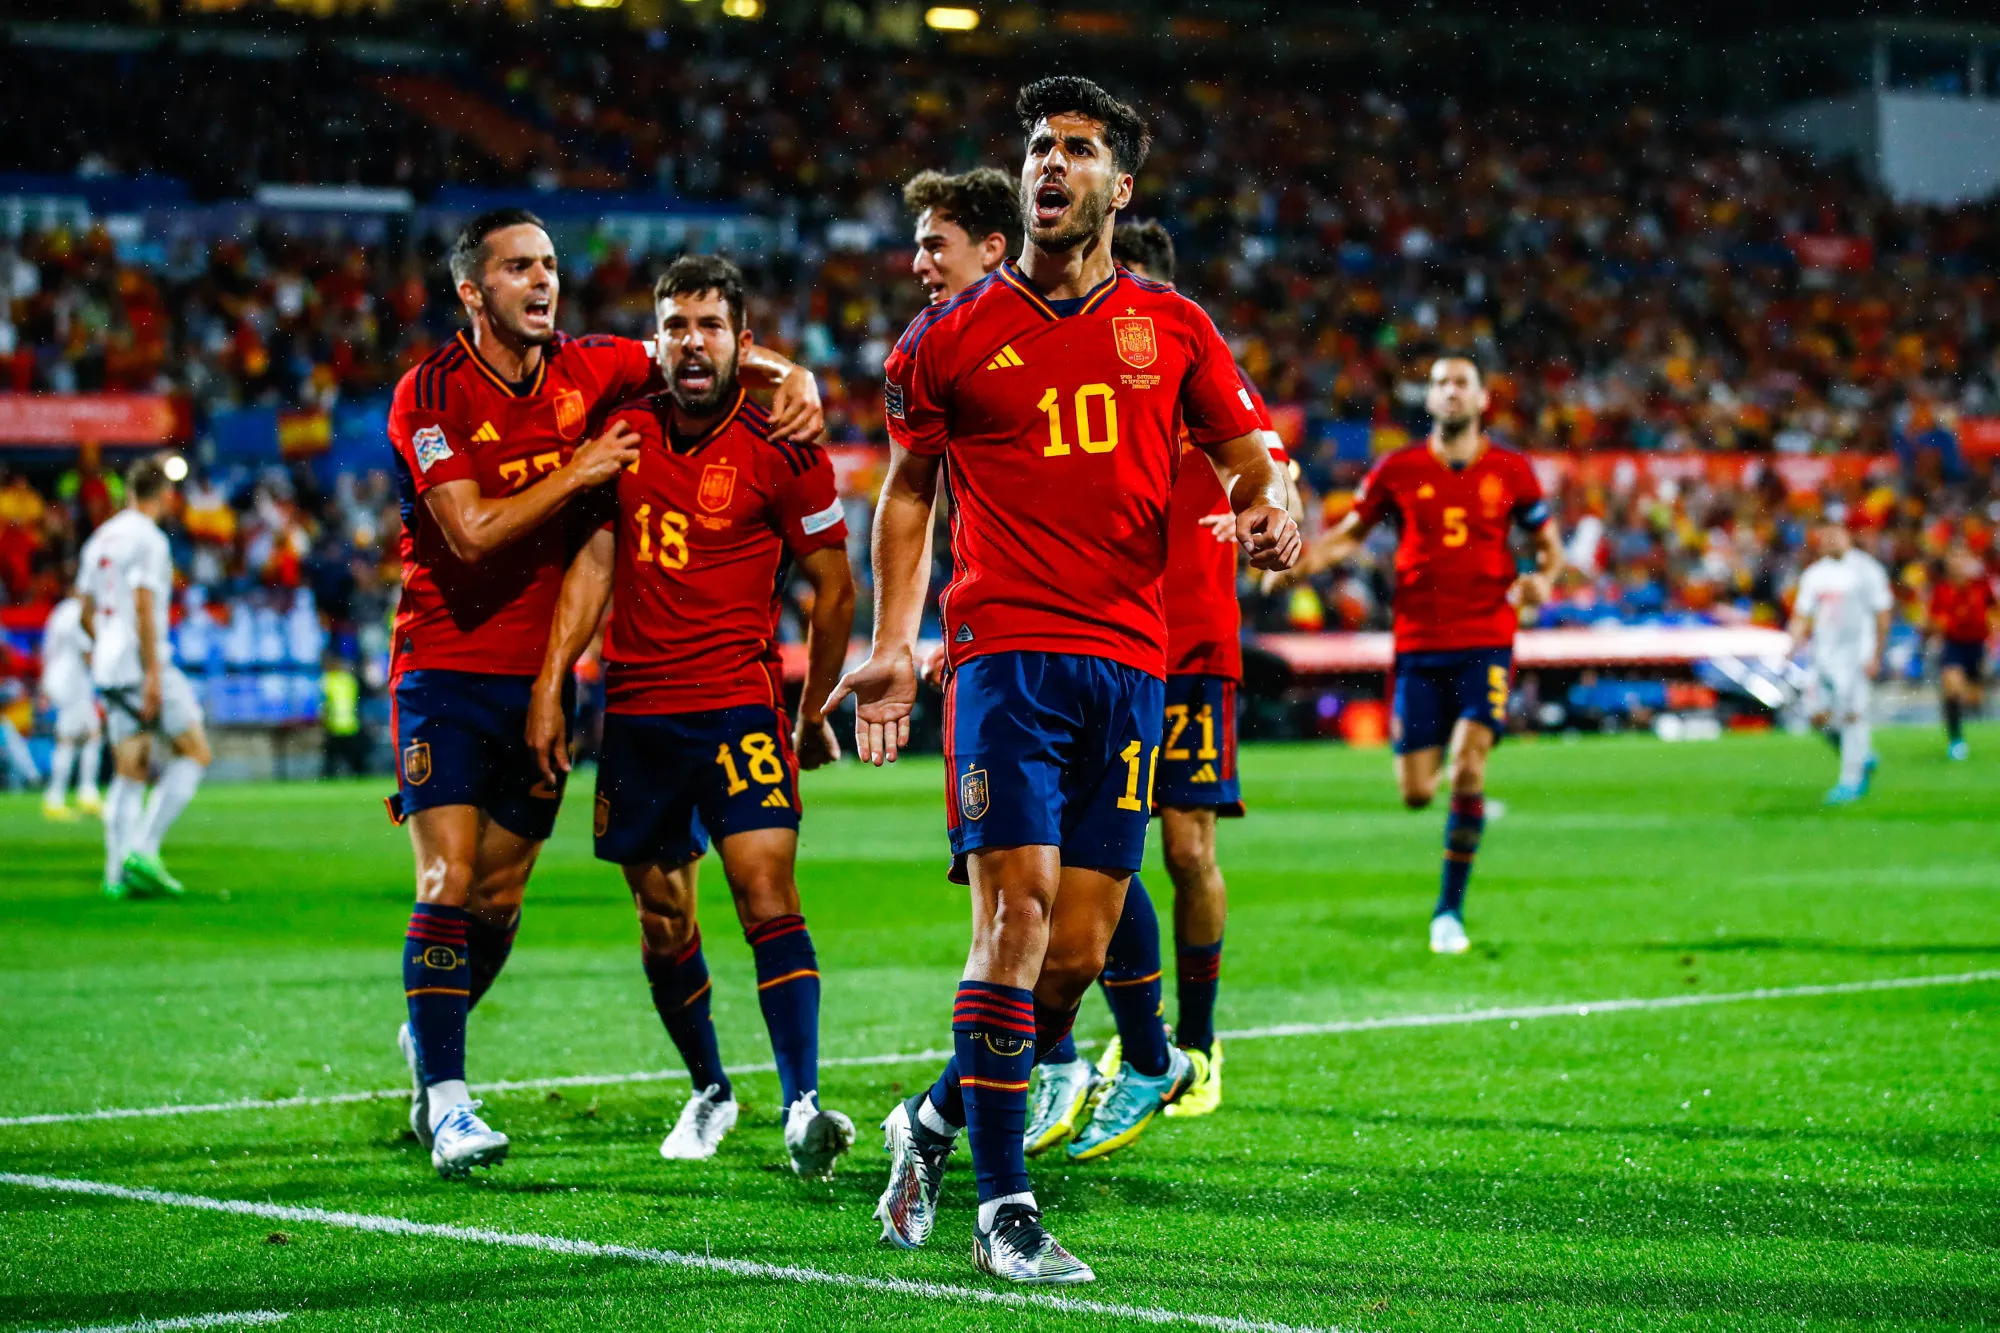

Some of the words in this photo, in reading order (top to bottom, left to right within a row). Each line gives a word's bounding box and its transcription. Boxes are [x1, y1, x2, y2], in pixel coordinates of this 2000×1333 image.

[1037, 383, 1119, 457] 10
[634, 503, 689, 570] 18
[1443, 507, 1468, 547] 5
[1164, 703, 1218, 760] 21
[715, 732, 784, 797] 18
